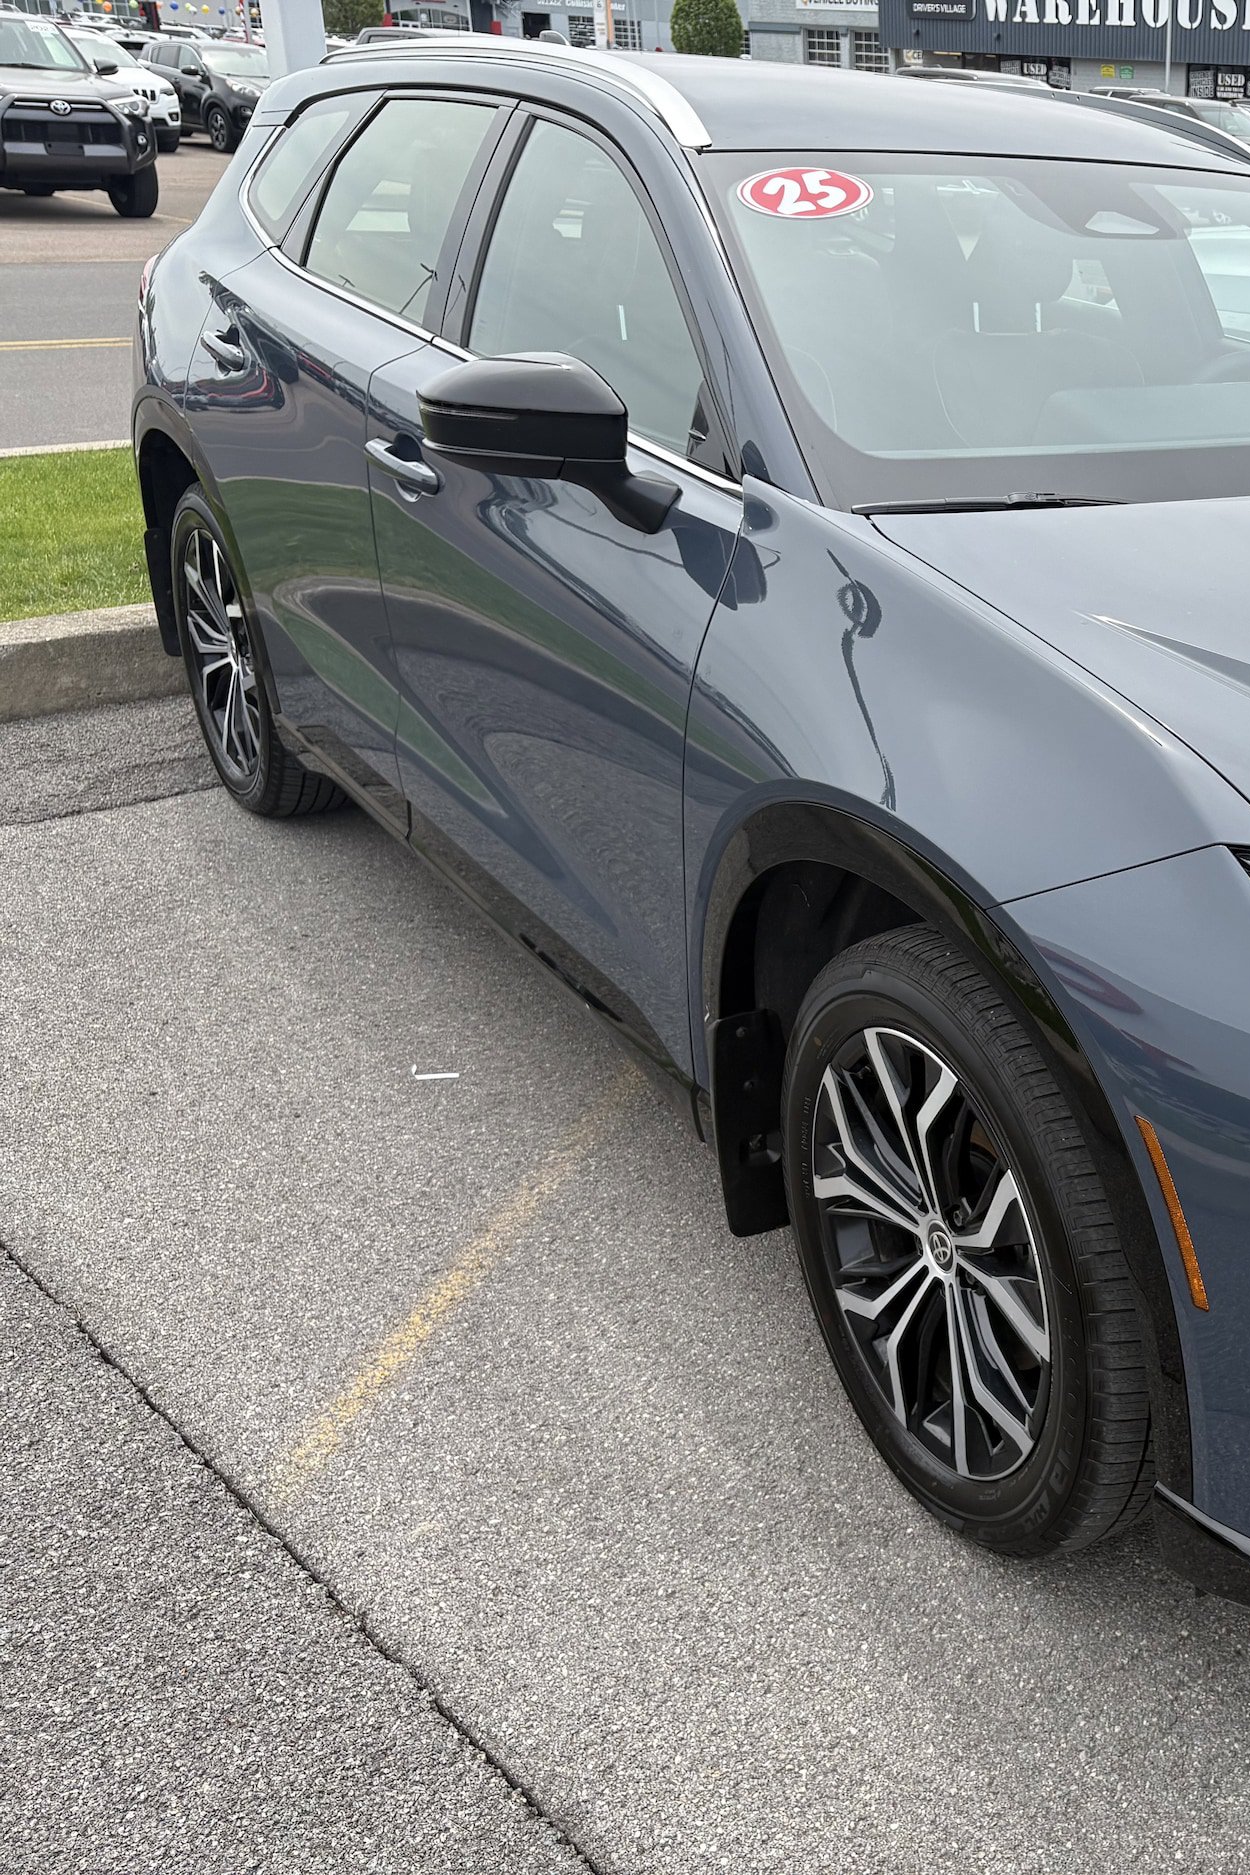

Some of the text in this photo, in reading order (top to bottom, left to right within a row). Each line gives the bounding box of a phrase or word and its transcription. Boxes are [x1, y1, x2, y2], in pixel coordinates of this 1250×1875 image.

[913, 3, 966, 14] DRIVER'S VILLAGE
[1023, 62, 1047, 75] USED
[1217, 73, 1246, 87] USED
[1190, 85, 1214, 98] INSIDE
[762, 171, 847, 215] 25
